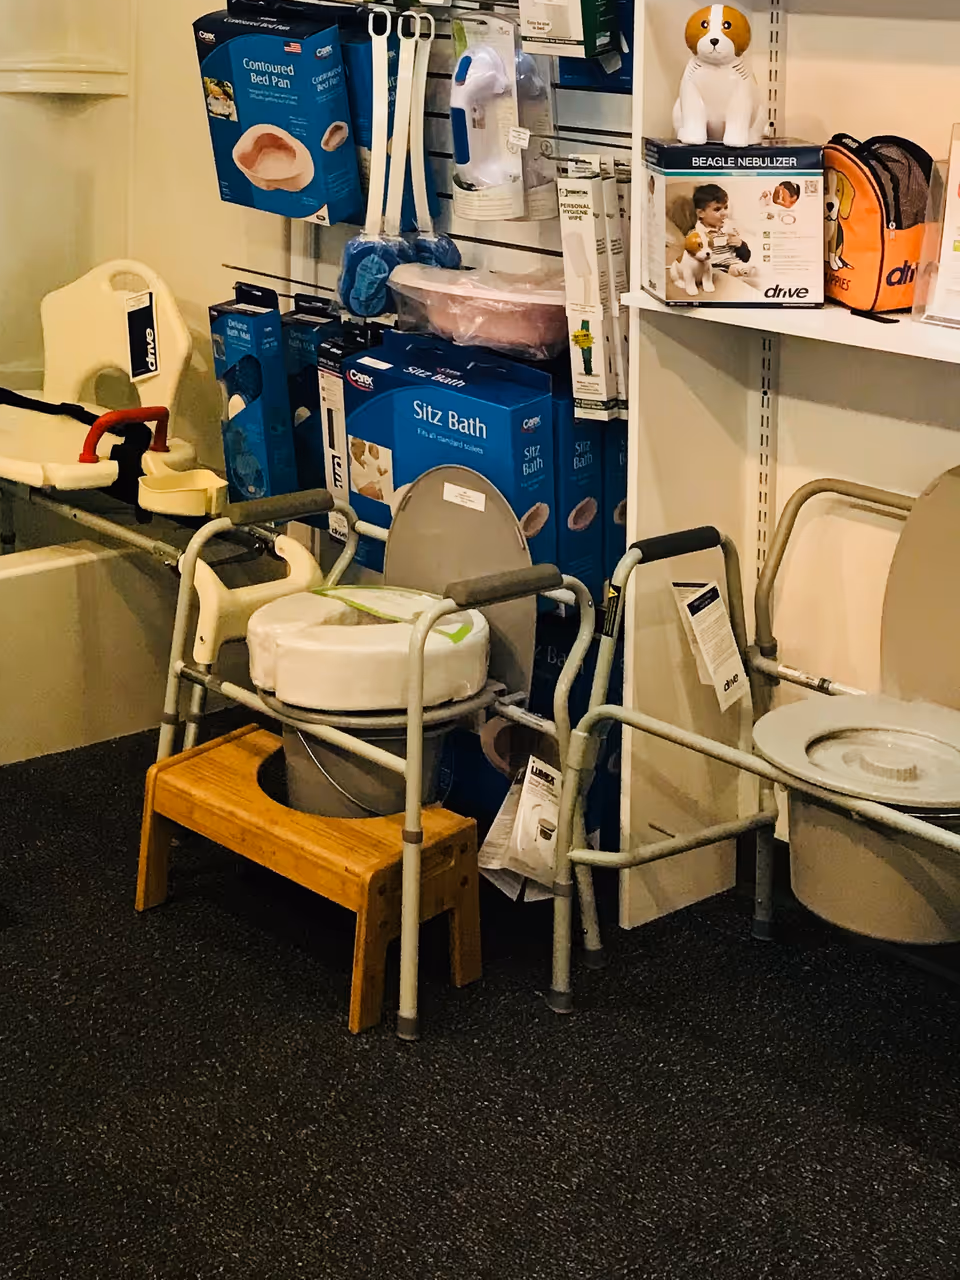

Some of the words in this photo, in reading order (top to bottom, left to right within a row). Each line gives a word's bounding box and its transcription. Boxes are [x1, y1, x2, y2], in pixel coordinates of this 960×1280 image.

[198, 30, 216, 40] Carex
[242, 57, 295, 76] Contoured
[250, 72, 270, 86] Bed
[271, 75, 291, 89] Pan
[311, 65, 342, 85] Contoured
[316, 81, 328, 92] Bed
[692, 157, 735, 167] BEAGLE
[737, 157, 798, 168] NEBULIZER
[764, 284, 809, 299] drive
[226, 328, 239, 337] Bath
[145, 327, 157, 371] drive
[349, 369, 374, 385] Carex
[403, 366, 433, 378] Sitz
[430, 372, 466, 388] Bath
[413, 400, 443, 426] Sitz
[448, 410, 488, 439] Bath
[522, 415, 541, 429] Carex
[437, 435, 464, 449] standard
[575, 440, 591, 455] Sitz
[524, 445, 540, 460] Sitz
[522, 458, 544, 475] Bath
[573, 453, 593, 469] Bath
[723, 673, 739, 693] drive
[530, 765, 557, 787] LUMEX
